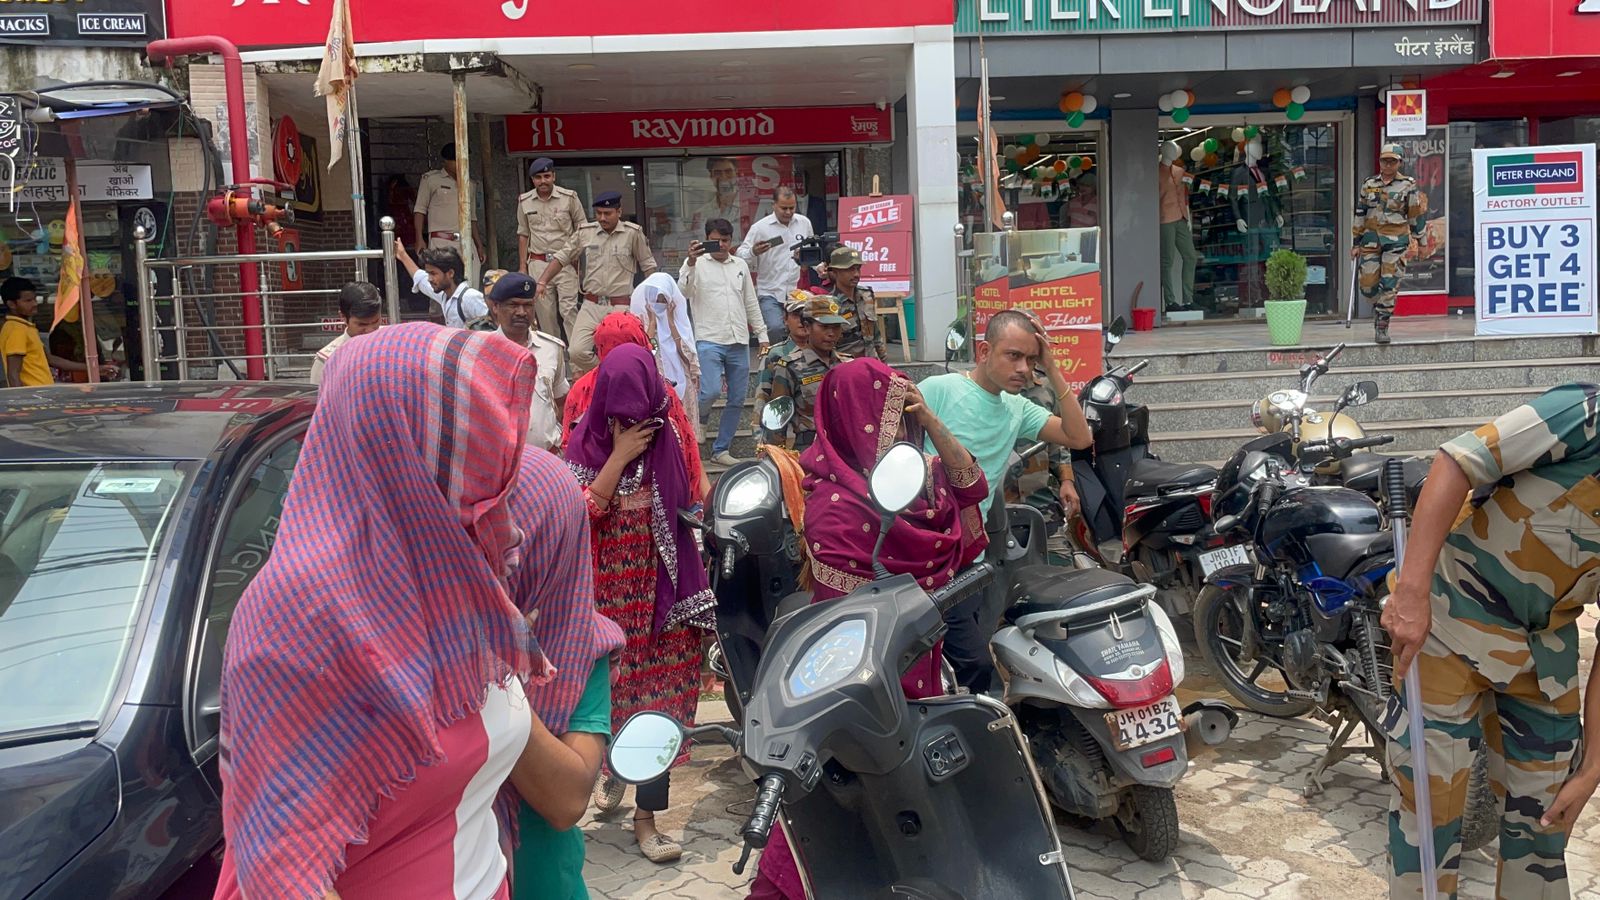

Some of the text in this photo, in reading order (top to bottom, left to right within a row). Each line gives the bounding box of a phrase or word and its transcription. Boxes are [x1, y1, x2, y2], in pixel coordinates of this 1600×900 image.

[82, 18, 141, 30] ICE CREAM
[1394, 33, 1475, 59] पीटर इंग्लैंड
[1496, 168, 1575, 181] PETER ENGLAND
[1487, 196, 1585, 209] FACTORY OUTLET
[851, 207, 899, 229] SALE
[864, 236, 874, 251] 2
[1488, 224, 1580, 250] BUY 3
[861, 246, 889, 262] Get 2
[879, 263, 897, 273] FREE
[1488, 252, 1580, 279] GET 4
[982, 288, 1001, 297] HOTEL
[1030, 286, 1077, 297] HOTEL
[1013, 298, 1095, 310] MOON LIGHT
[1045, 313, 1092, 327] Floor
[1120, 701, 1170, 726] JH 01BZ
